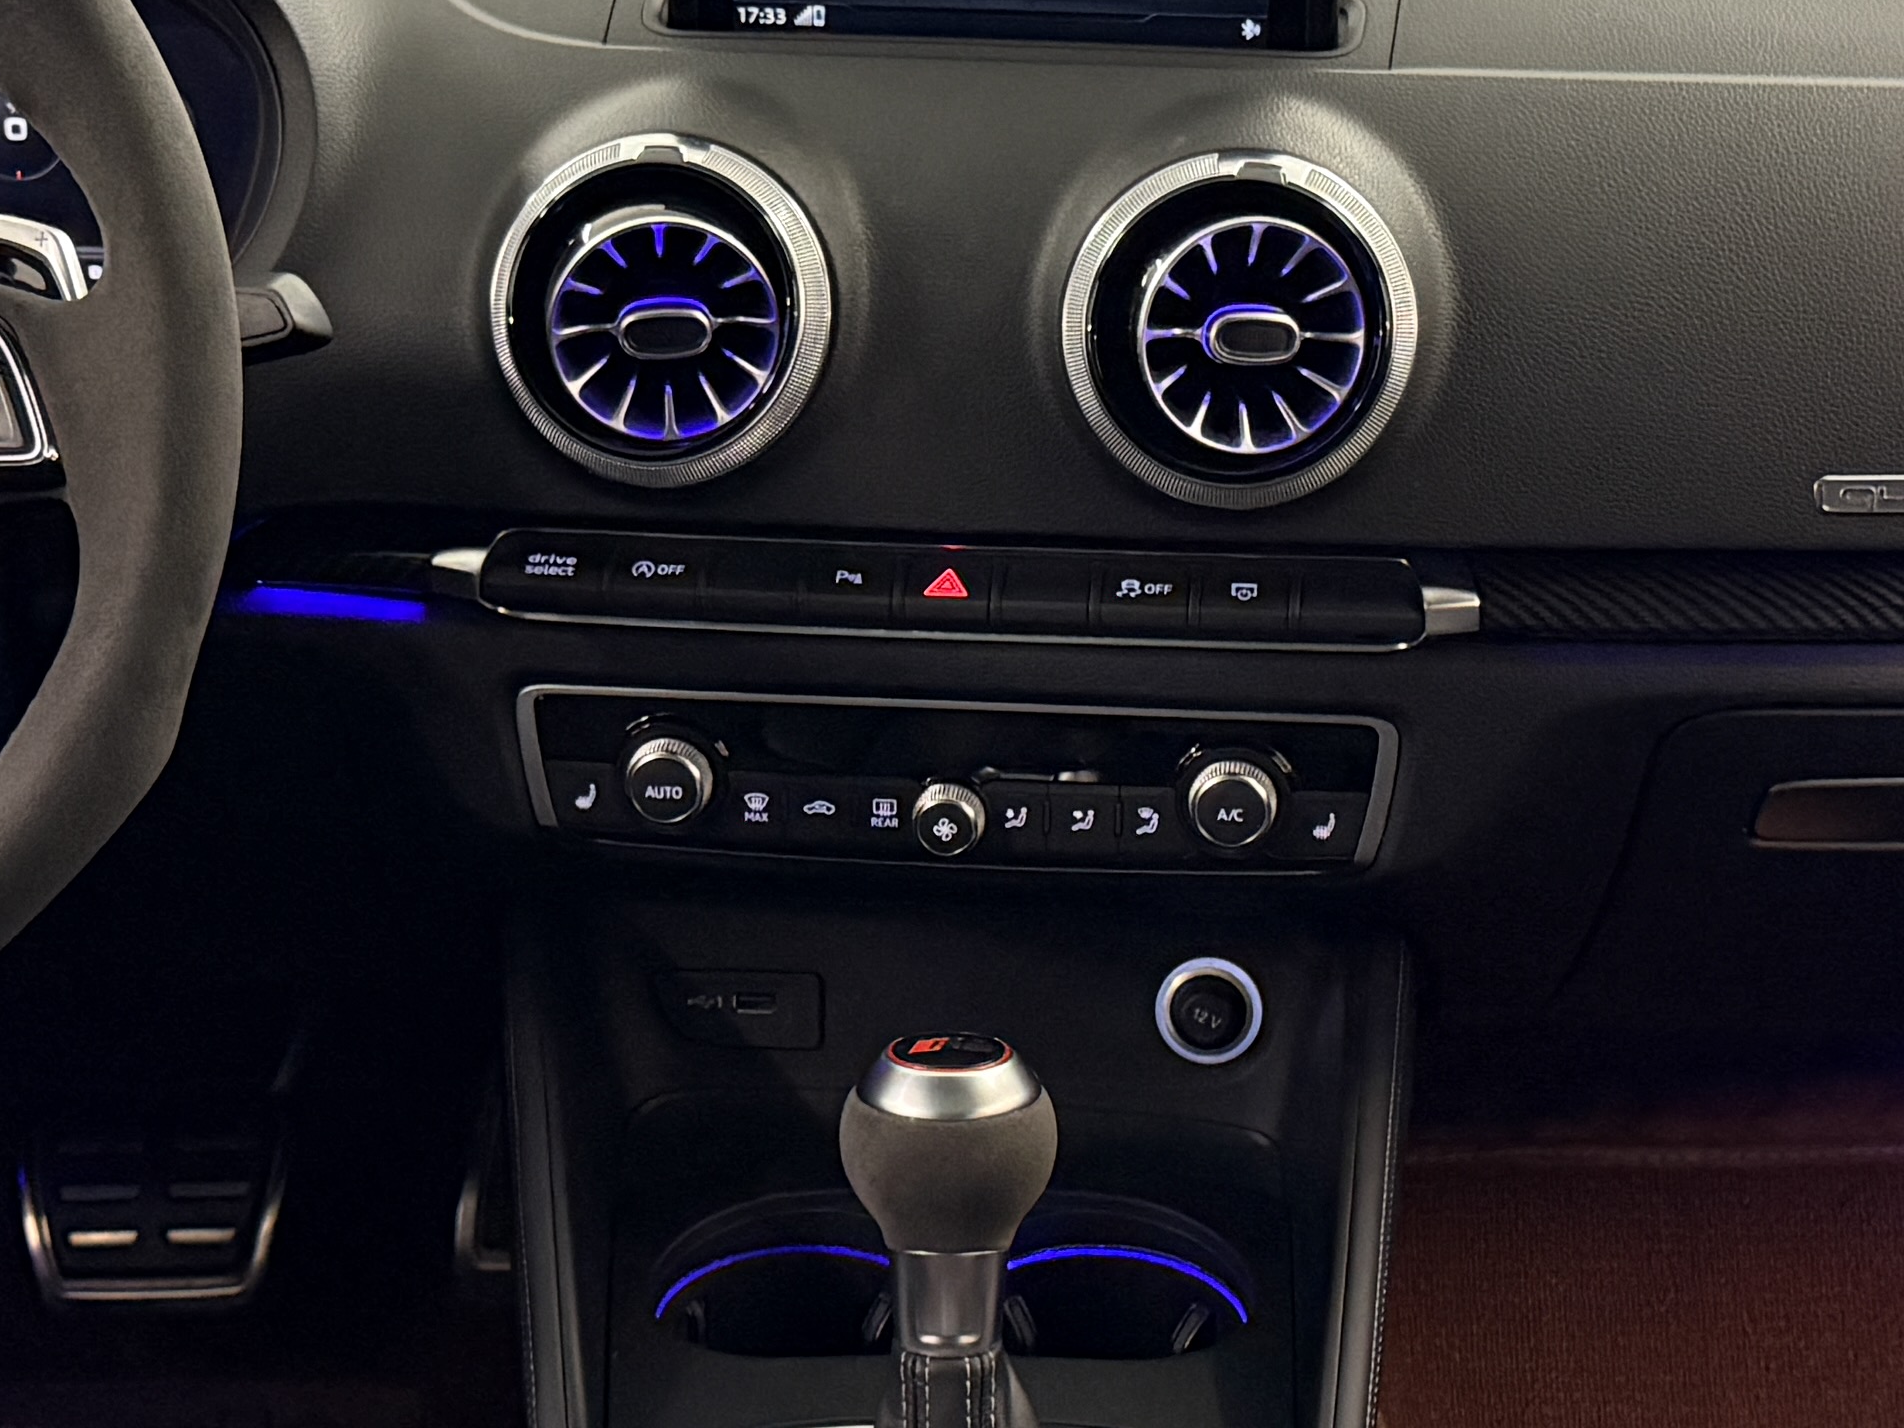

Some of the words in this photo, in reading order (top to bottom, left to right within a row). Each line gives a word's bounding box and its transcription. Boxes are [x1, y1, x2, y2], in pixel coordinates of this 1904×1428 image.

[737, 7, 787, 27] 17:33
[3, 116, 29, 142] 0
[527, 552, 578, 566] drive
[524, 563, 576, 577] select
[656, 564, 686, 576] OFF
[1144, 582, 1174, 596] OFF
[644, 785, 684, 800] AUTO
[743, 811, 770, 823] MAX
[1216, 807, 1244, 822] A/C
[870, 816, 900, 829] REAR
